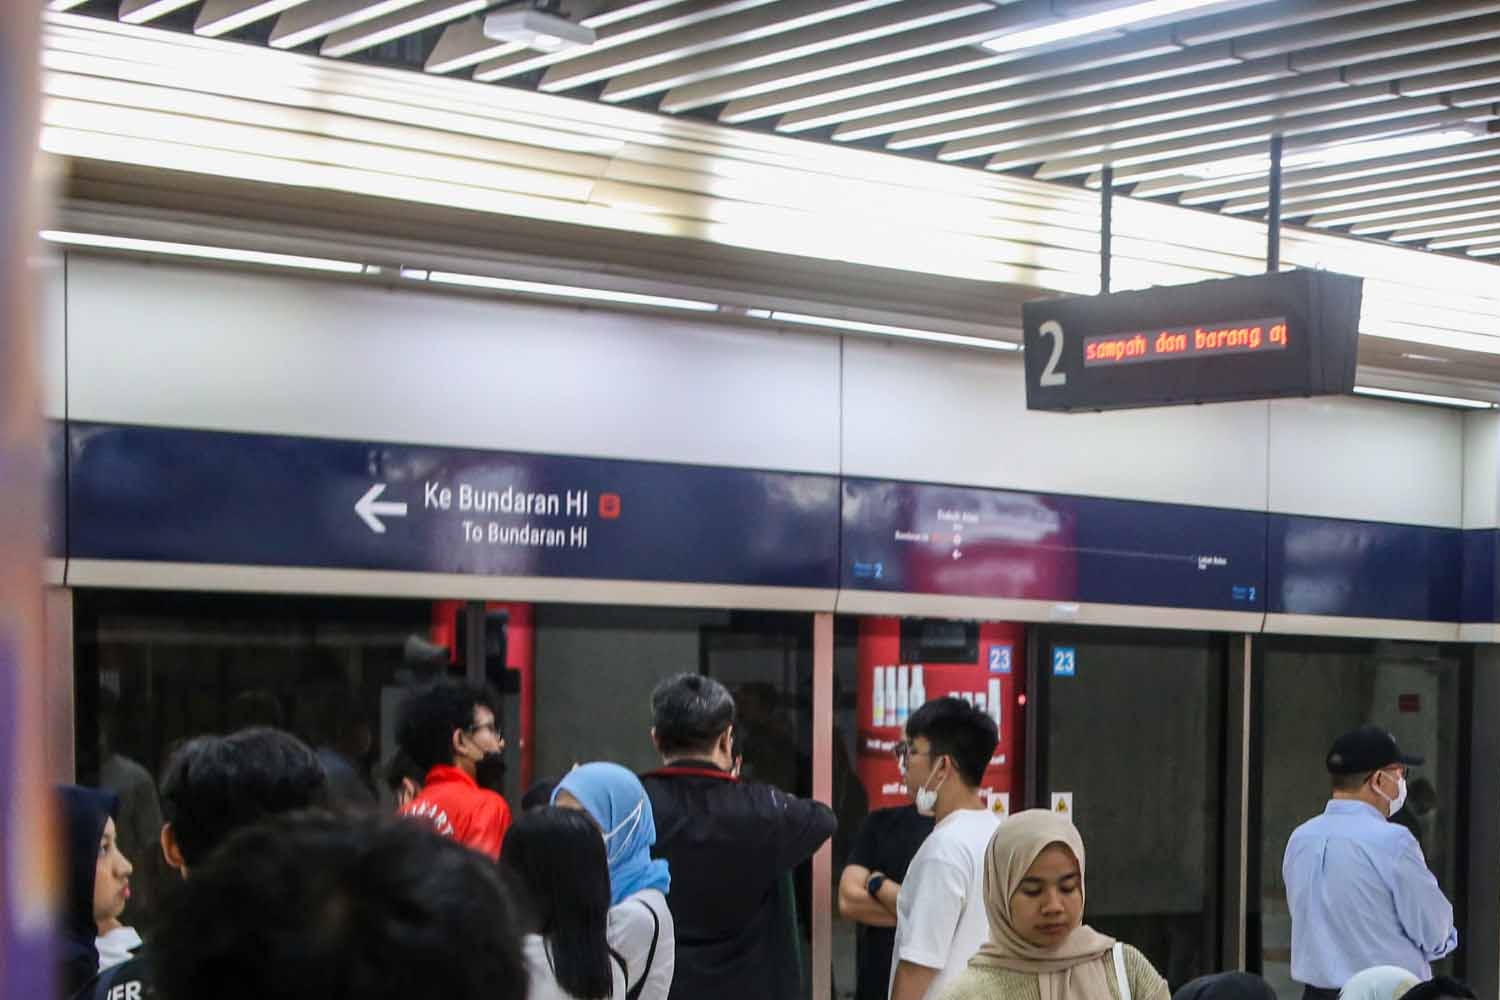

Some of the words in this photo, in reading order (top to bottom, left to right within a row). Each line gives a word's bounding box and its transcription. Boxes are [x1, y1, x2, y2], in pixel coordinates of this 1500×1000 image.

[1039, 320, 1067, 387] 2
[1155, 331, 1187, 354] dan
[1194, 325, 1262, 349] barang
[424, 481, 452, 510] Ke
[459, 484, 559, 514] Bundaran
[566, 489, 588, 517] HI
[462, 520, 483, 542] To
[488, 521, 565, 547] Bundaran
[570, 526, 588, 548] HI
[990, 650, 1010, 671] 23
[1054, 651, 1075, 672] 23
